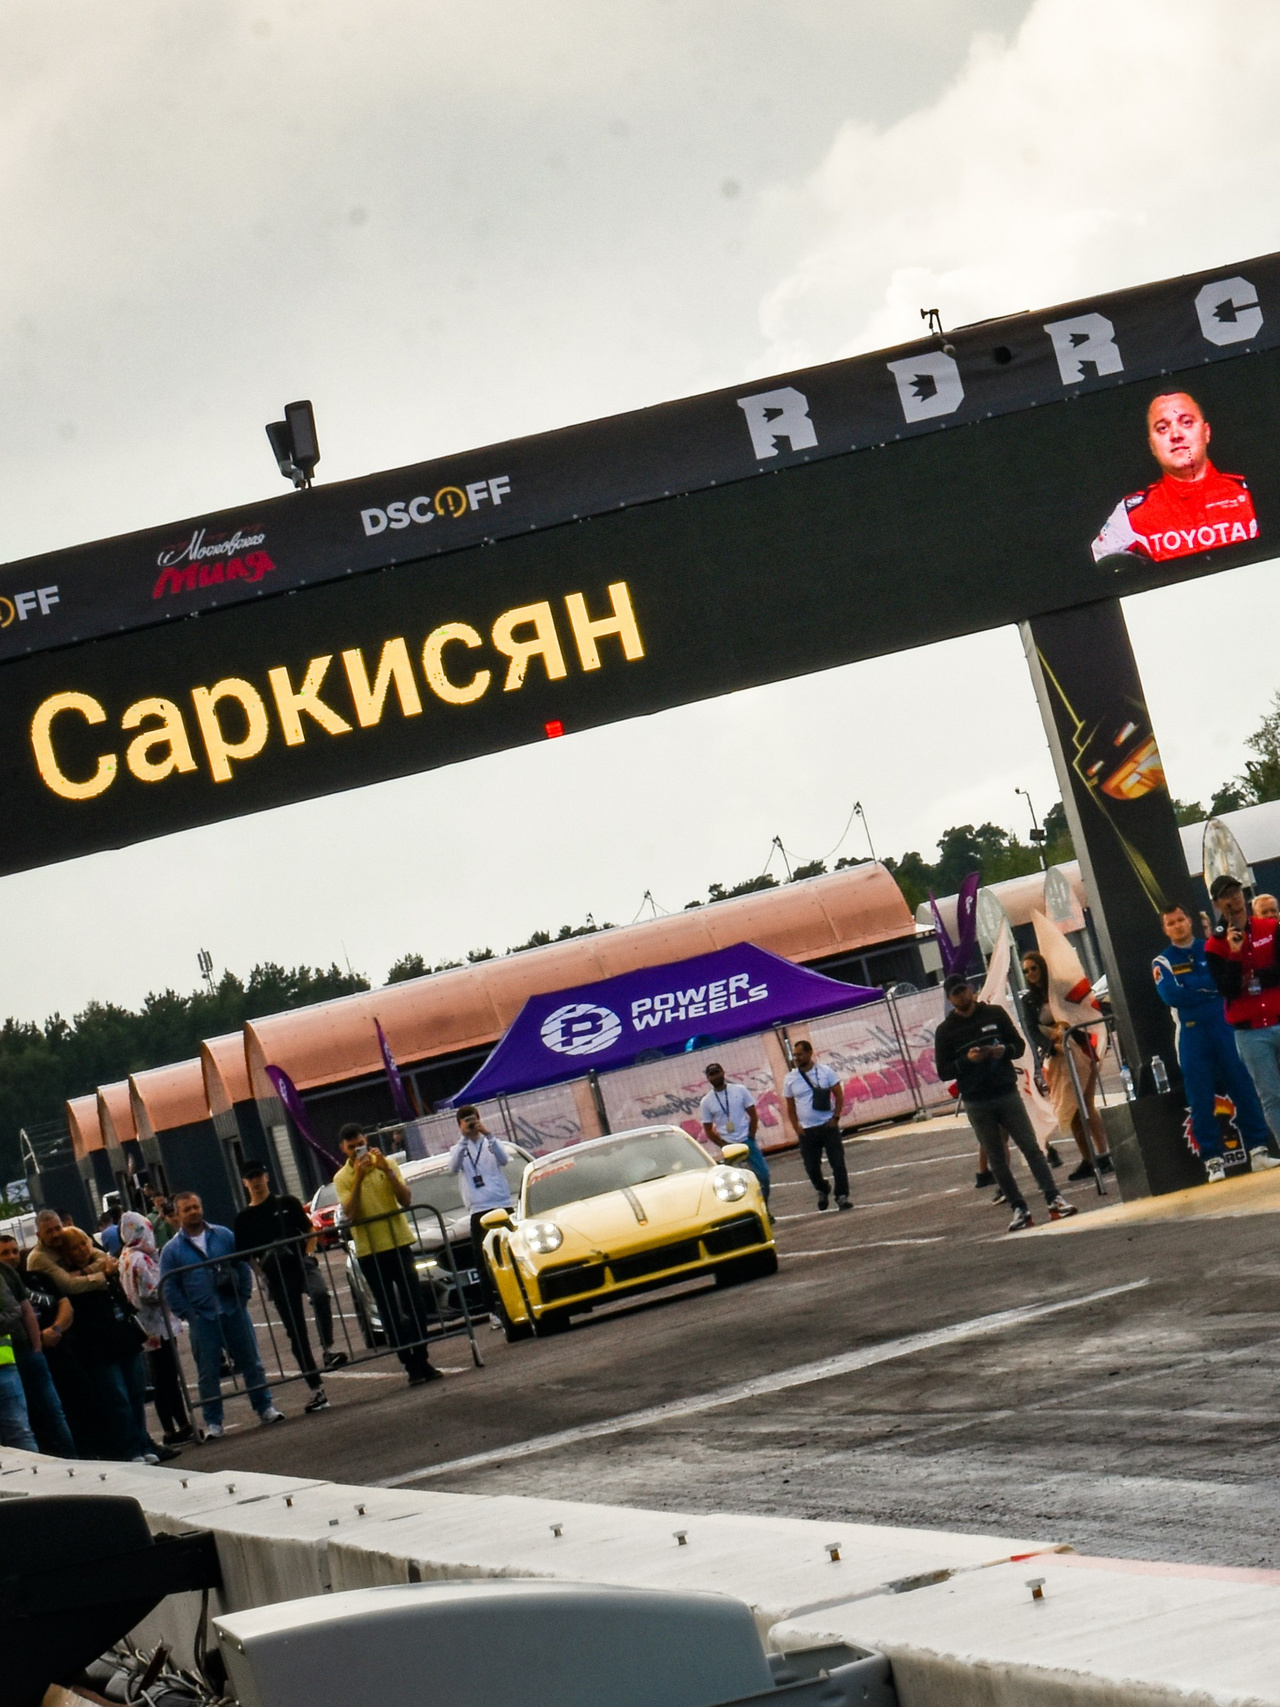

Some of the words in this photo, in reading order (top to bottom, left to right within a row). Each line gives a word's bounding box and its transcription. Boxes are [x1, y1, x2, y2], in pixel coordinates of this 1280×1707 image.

[1149, 521, 1248, 553] TOYOTA
[28, 580, 645, 800] Саркисян
[631, 972, 750, 1018] POWER
[631, 983, 769, 1032] WHEELS
